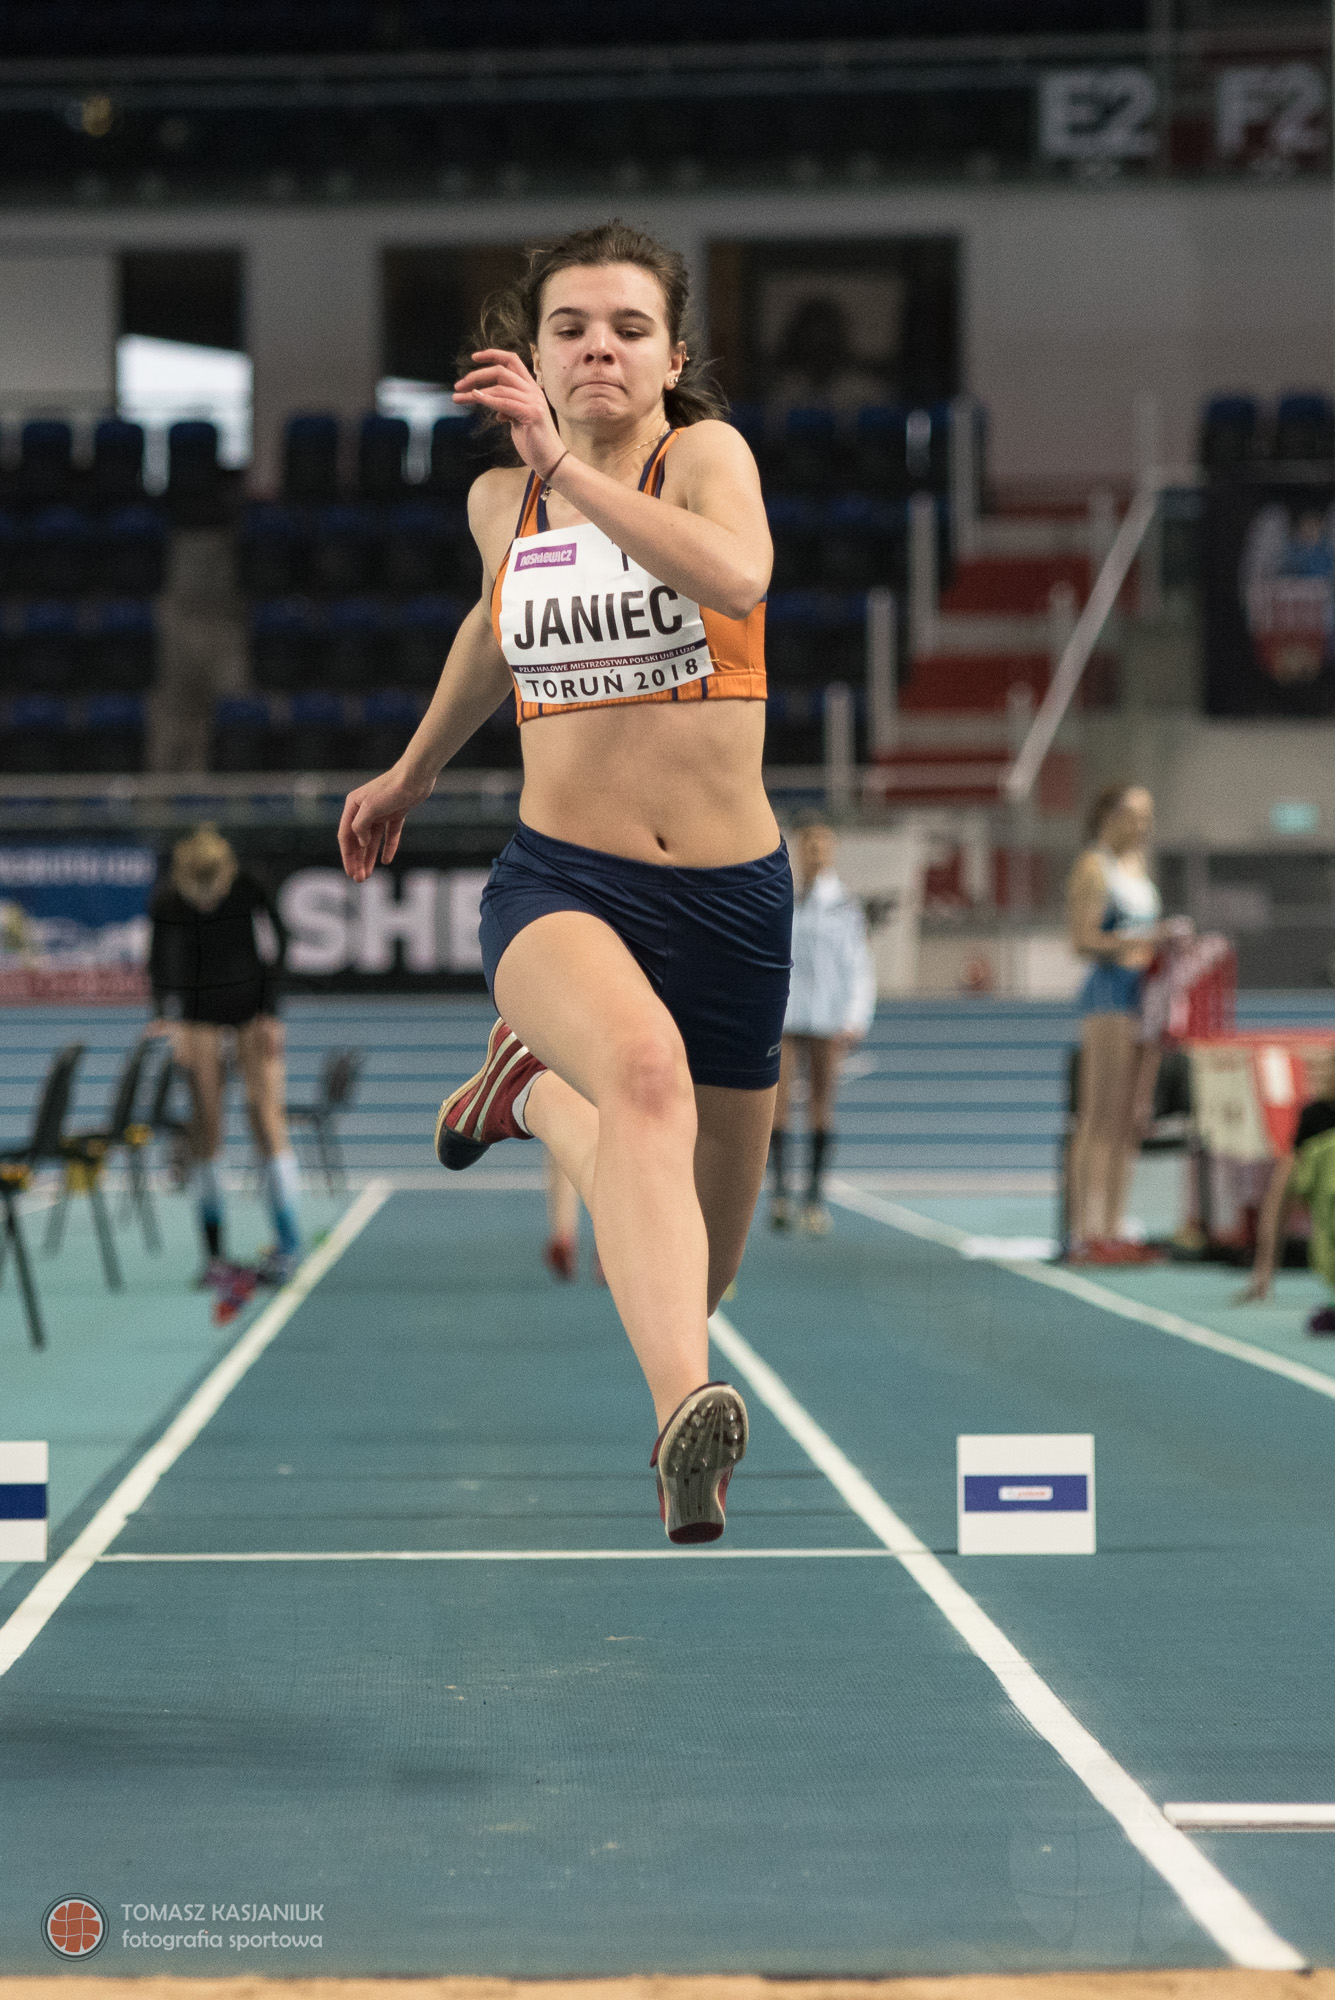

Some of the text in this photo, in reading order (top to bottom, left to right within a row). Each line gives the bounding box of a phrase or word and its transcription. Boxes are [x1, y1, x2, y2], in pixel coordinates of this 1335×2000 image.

[1040, 66, 1158, 155] E2
[1216, 62, 1329, 153] F2
[513, 585, 683, 650] JANIEC
[525, 658, 699, 700] TORUŃ 2018
[537, 664, 568, 673] HALOWE
[570, 658, 629, 670] MISTRZOSTWA
[630, 655, 658, 664] POLSKI
